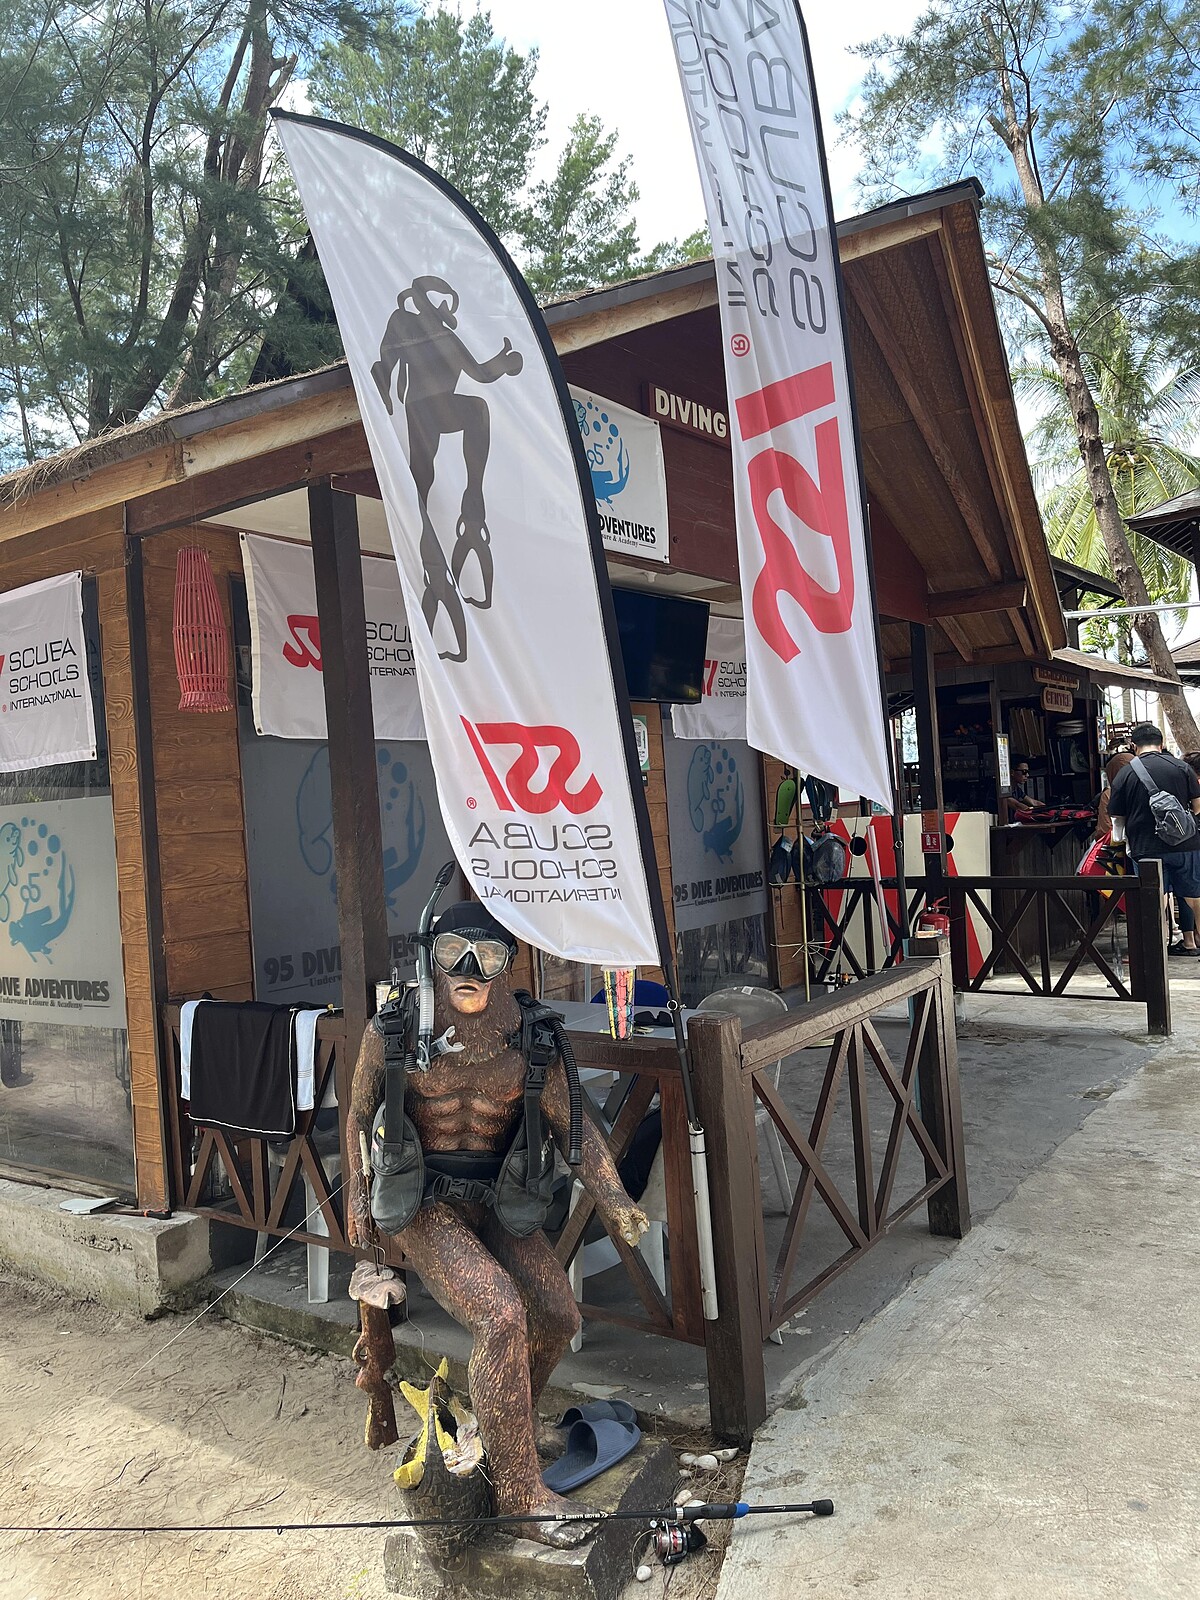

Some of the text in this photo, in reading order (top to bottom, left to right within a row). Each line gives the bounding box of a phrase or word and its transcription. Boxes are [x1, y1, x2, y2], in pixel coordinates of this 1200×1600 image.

[655, 387, 728, 439] DIVING
[367, 646, 416, 661] SCHO
[674, 870, 764, 902] 95 DIVE ADVENTURES
[263, 954, 295, 985] 95
[25, 978, 110, 1003] ADVENTURES
